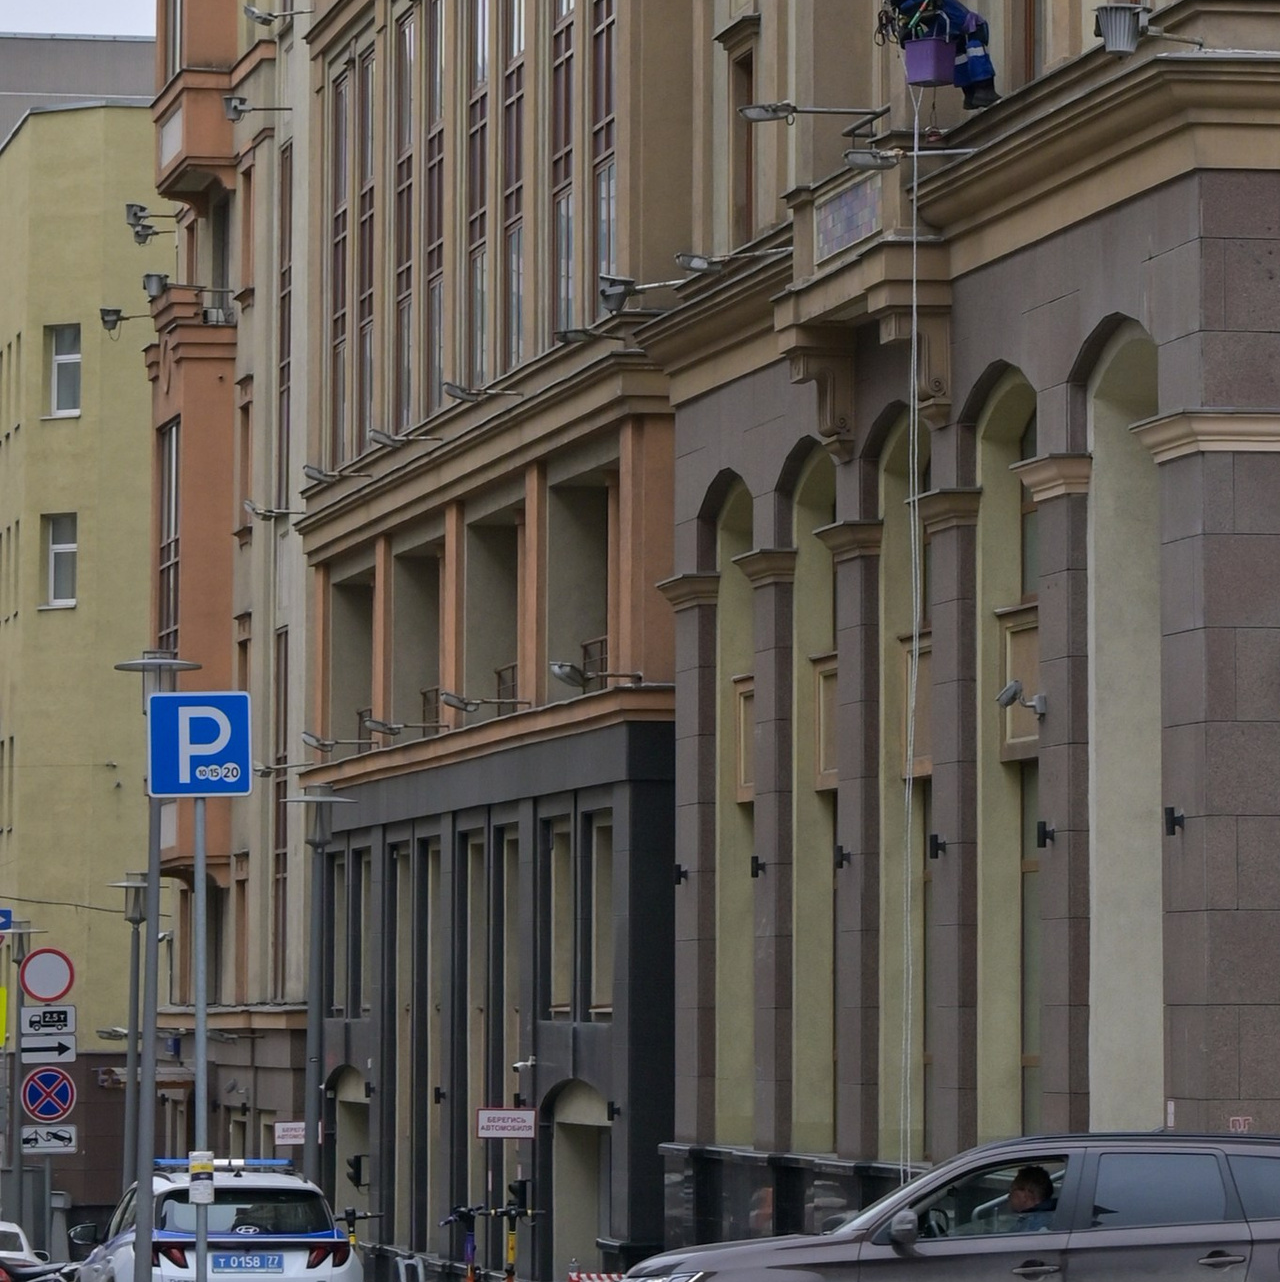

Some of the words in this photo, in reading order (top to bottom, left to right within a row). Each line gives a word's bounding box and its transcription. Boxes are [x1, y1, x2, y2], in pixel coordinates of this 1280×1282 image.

[178, 705, 231, 784] P
[198, 769, 207, 777] 10
[210, 768, 219, 777] 15
[223, 767, 239, 778] 20
[230, 1256, 260, 1268] 0158
[267, 1255, 278, 1264] 77
